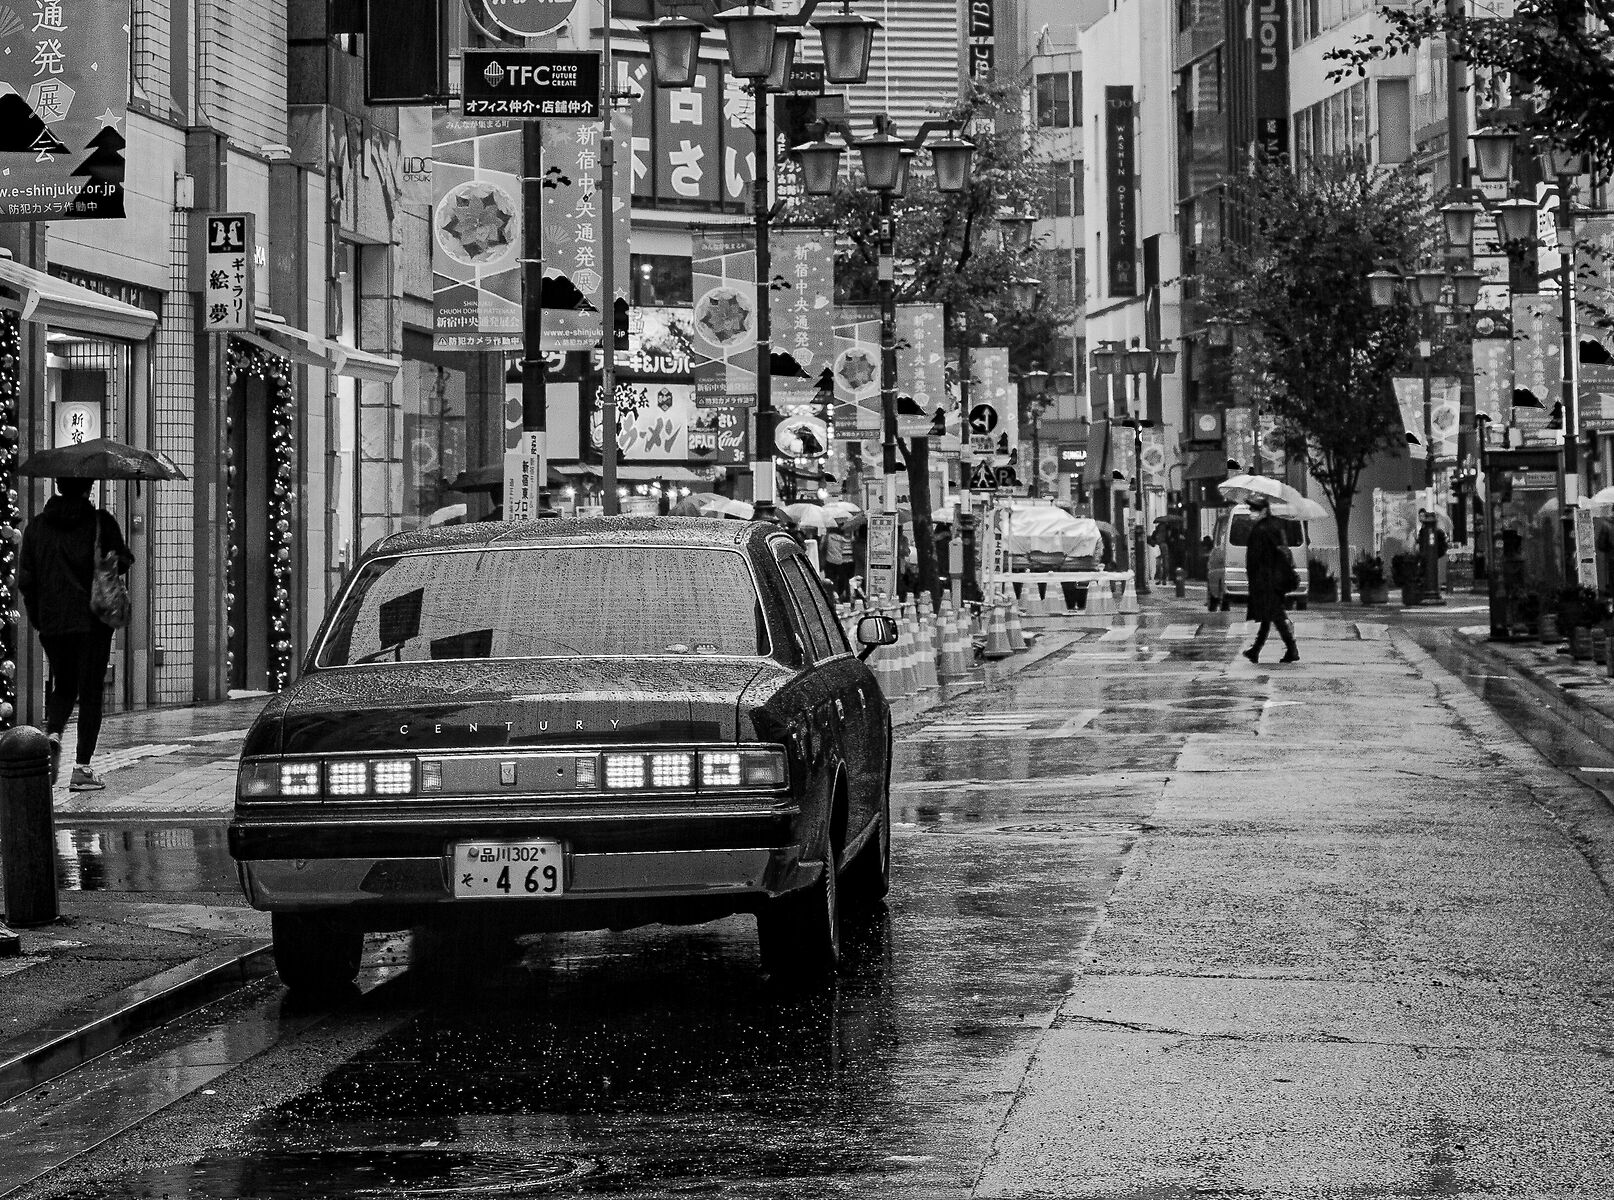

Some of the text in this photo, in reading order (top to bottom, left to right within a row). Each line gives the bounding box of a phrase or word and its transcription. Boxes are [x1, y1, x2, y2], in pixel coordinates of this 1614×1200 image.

[507, 65, 551, 87] TFC
[466, 100, 594, 114] オフィス仲介・店舗仲介
[1116, 125, 1126, 175] WASHIN
[402, 174, 432, 183] OTSUK
[8, 201, 98, 216] 防犯カメラ作動中
[209, 269, 230, 324] 絵夢
[231, 257, 244, 324] ギャラリー
[448, 336, 520, 346] 防犯カメラ作動中
[400, 719, 620, 735] CENTURY
